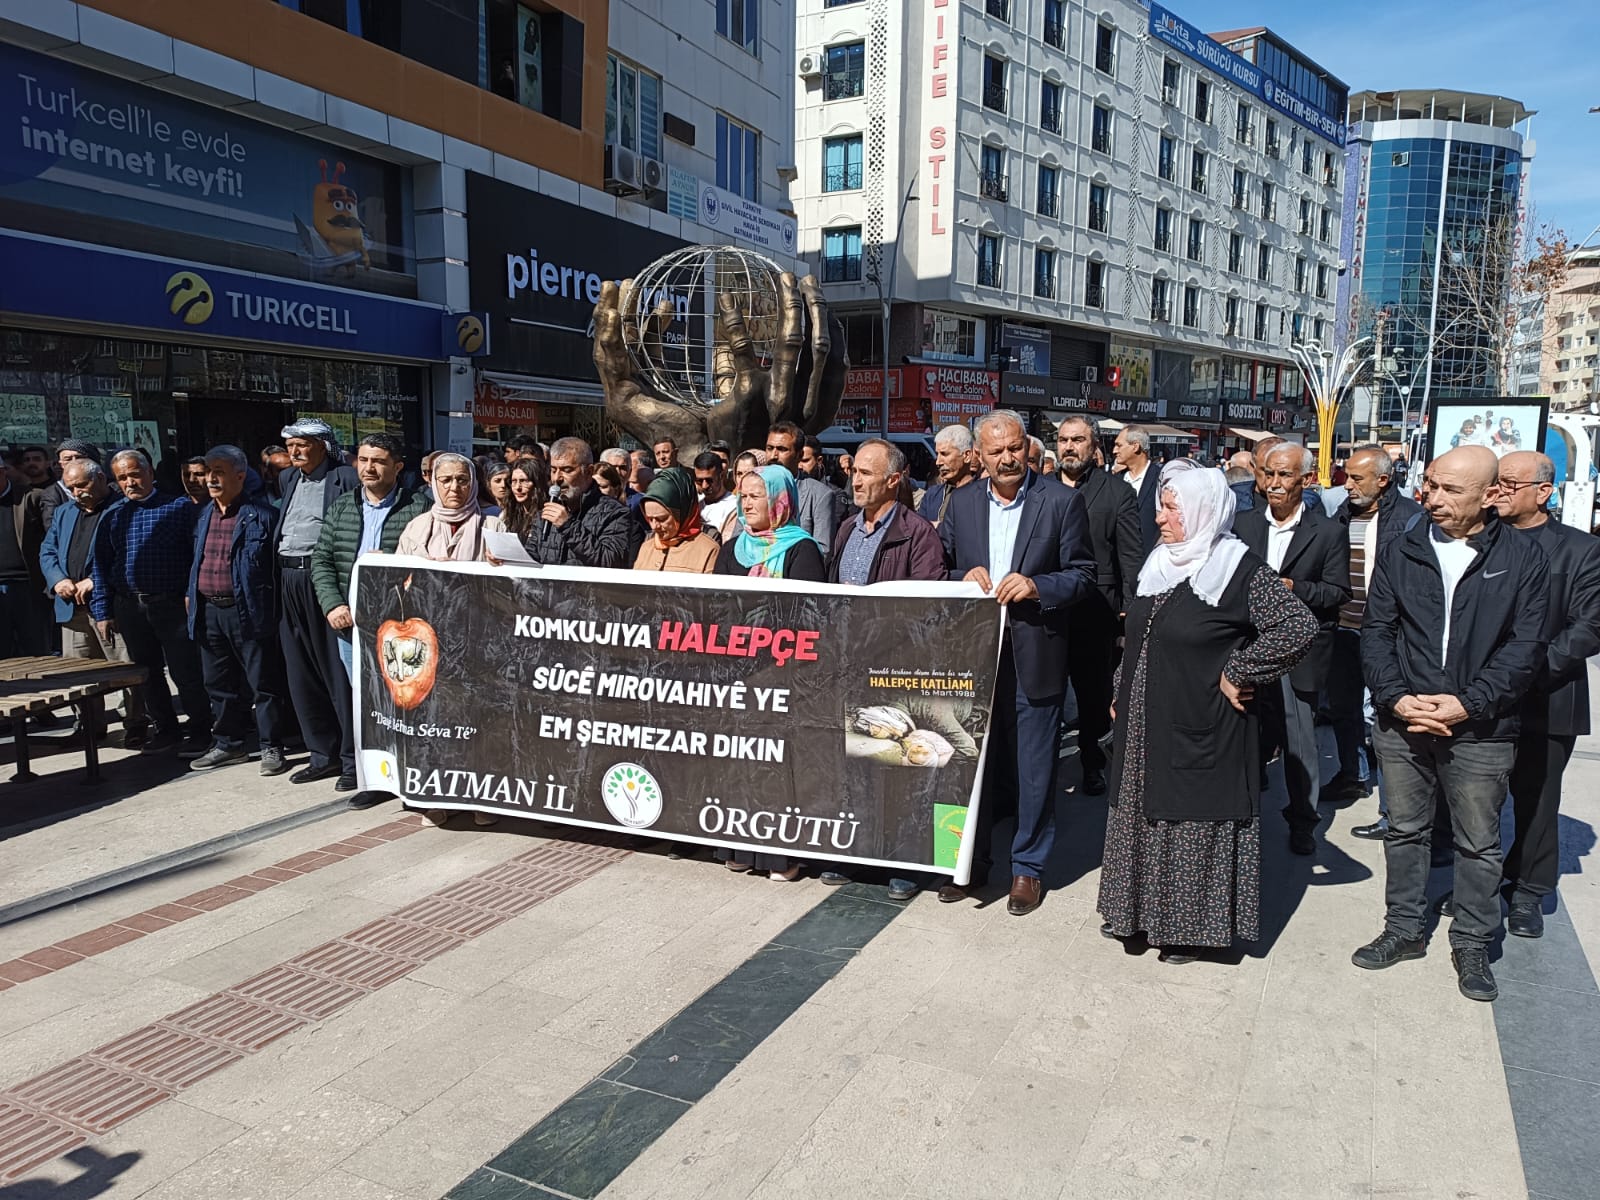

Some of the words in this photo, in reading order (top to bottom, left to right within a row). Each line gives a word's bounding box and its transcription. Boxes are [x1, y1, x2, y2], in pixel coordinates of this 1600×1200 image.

[1161, 13, 1189, 41] Nokta
[1196, 39, 1231, 72] SÜRÜCÜ
[1232, 63, 1260, 89] KURSU
[21, 116, 155, 178] internet
[164, 152, 244, 198] keyfi!
[181, 127, 247, 163] evde
[506, 248, 601, 304] pierre
[224, 290, 359, 336] TURKCELL
[514, 613, 652, 649] KOMKUJIYA
[658, 621, 820, 667] HALEPÇE
[532, 662, 594, 695] SÛCÊ
[597, 676, 747, 711] MIROVAHIYÊ
[754, 688, 790, 713] YE
[869, 676, 919, 690] HALEPÇE
[920, 677, 973, 690] KATLİAMI
[920, 689, 931, 697] 16
[932, 689, 954, 697] Mart
[954, 690, 976, 698] 1988
[539, 715, 571, 741] EM
[576, 718, 707, 756] ŞERMEZAR
[713, 735, 785, 764] DIKIN
[405, 766, 539, 807] BATMAN
[542, 774, 575, 813] İL
[698, 796, 861, 850] ÖRGÜTÜ
